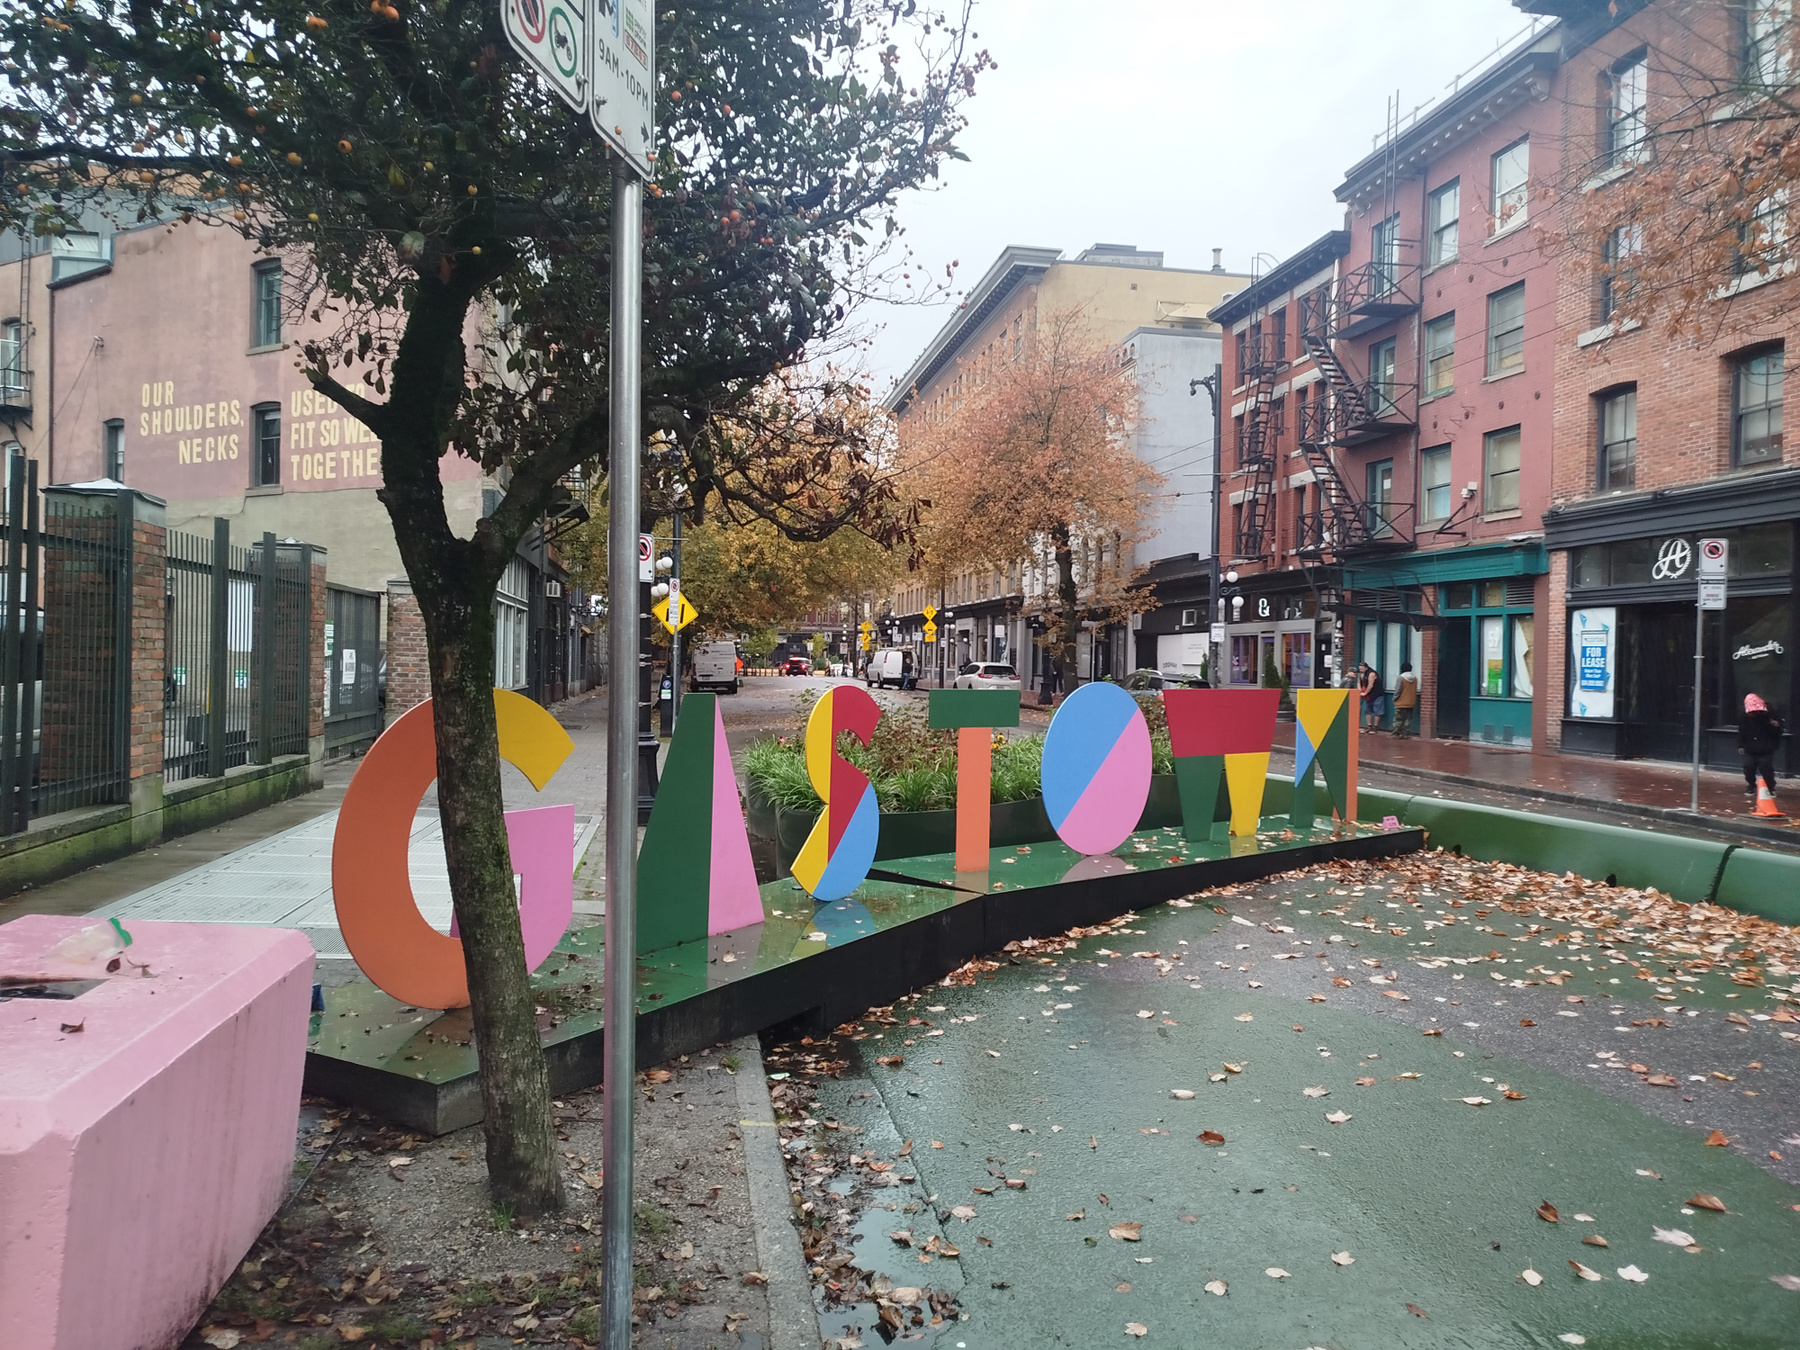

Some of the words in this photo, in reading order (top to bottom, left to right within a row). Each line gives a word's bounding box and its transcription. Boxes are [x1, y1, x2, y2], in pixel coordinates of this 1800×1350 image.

[142, 380, 174, 407] OUR
[140, 399, 244, 436] SHOULDERS,
[291, 421, 315, 449] FIT
[320, 418, 340, 447] SO
[343, 417, 382, 444] WEL
[179, 434, 239, 464] NECKS
[291, 447, 378, 481] TOGETHE
[1258, 597, 1271, 618] &
[1581, 657, 1605, 668] LEASE
[1586, 647, 1602, 657] FOR
[332, 682, 1360, 1010] GASTOWN
